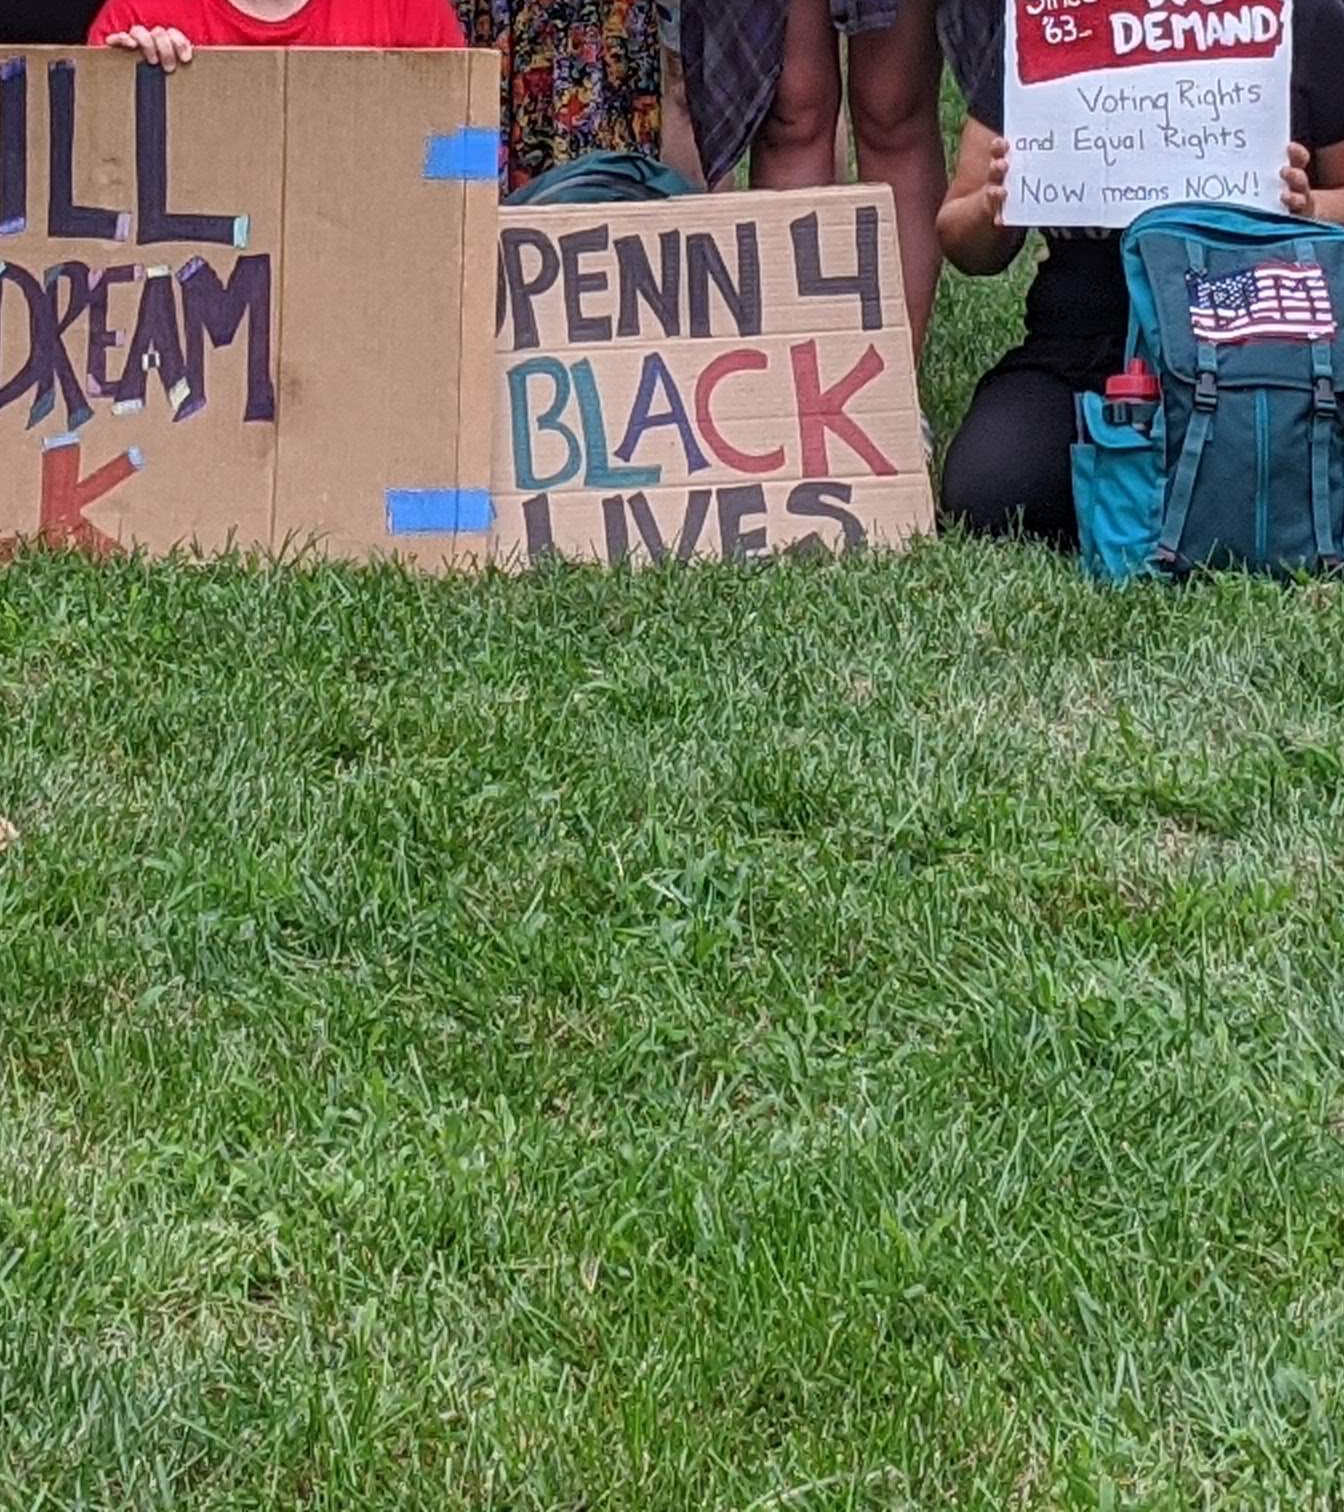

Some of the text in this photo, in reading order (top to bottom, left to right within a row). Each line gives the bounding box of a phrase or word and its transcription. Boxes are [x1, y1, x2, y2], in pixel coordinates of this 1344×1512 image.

[1109, 5, 1279, 55] DEMAND
[1077, 79, 1262, 129] Voting Rights
[1015, 125, 1247, 166] and Equal Rights
[1102, 185, 1170, 202] means
[1185, 172, 1260, 200] NOW!
[495, 205, 884, 351] PENN 4
[505, 339, 899, 491] BLACK
[521, 481, 865, 568] LIVES
